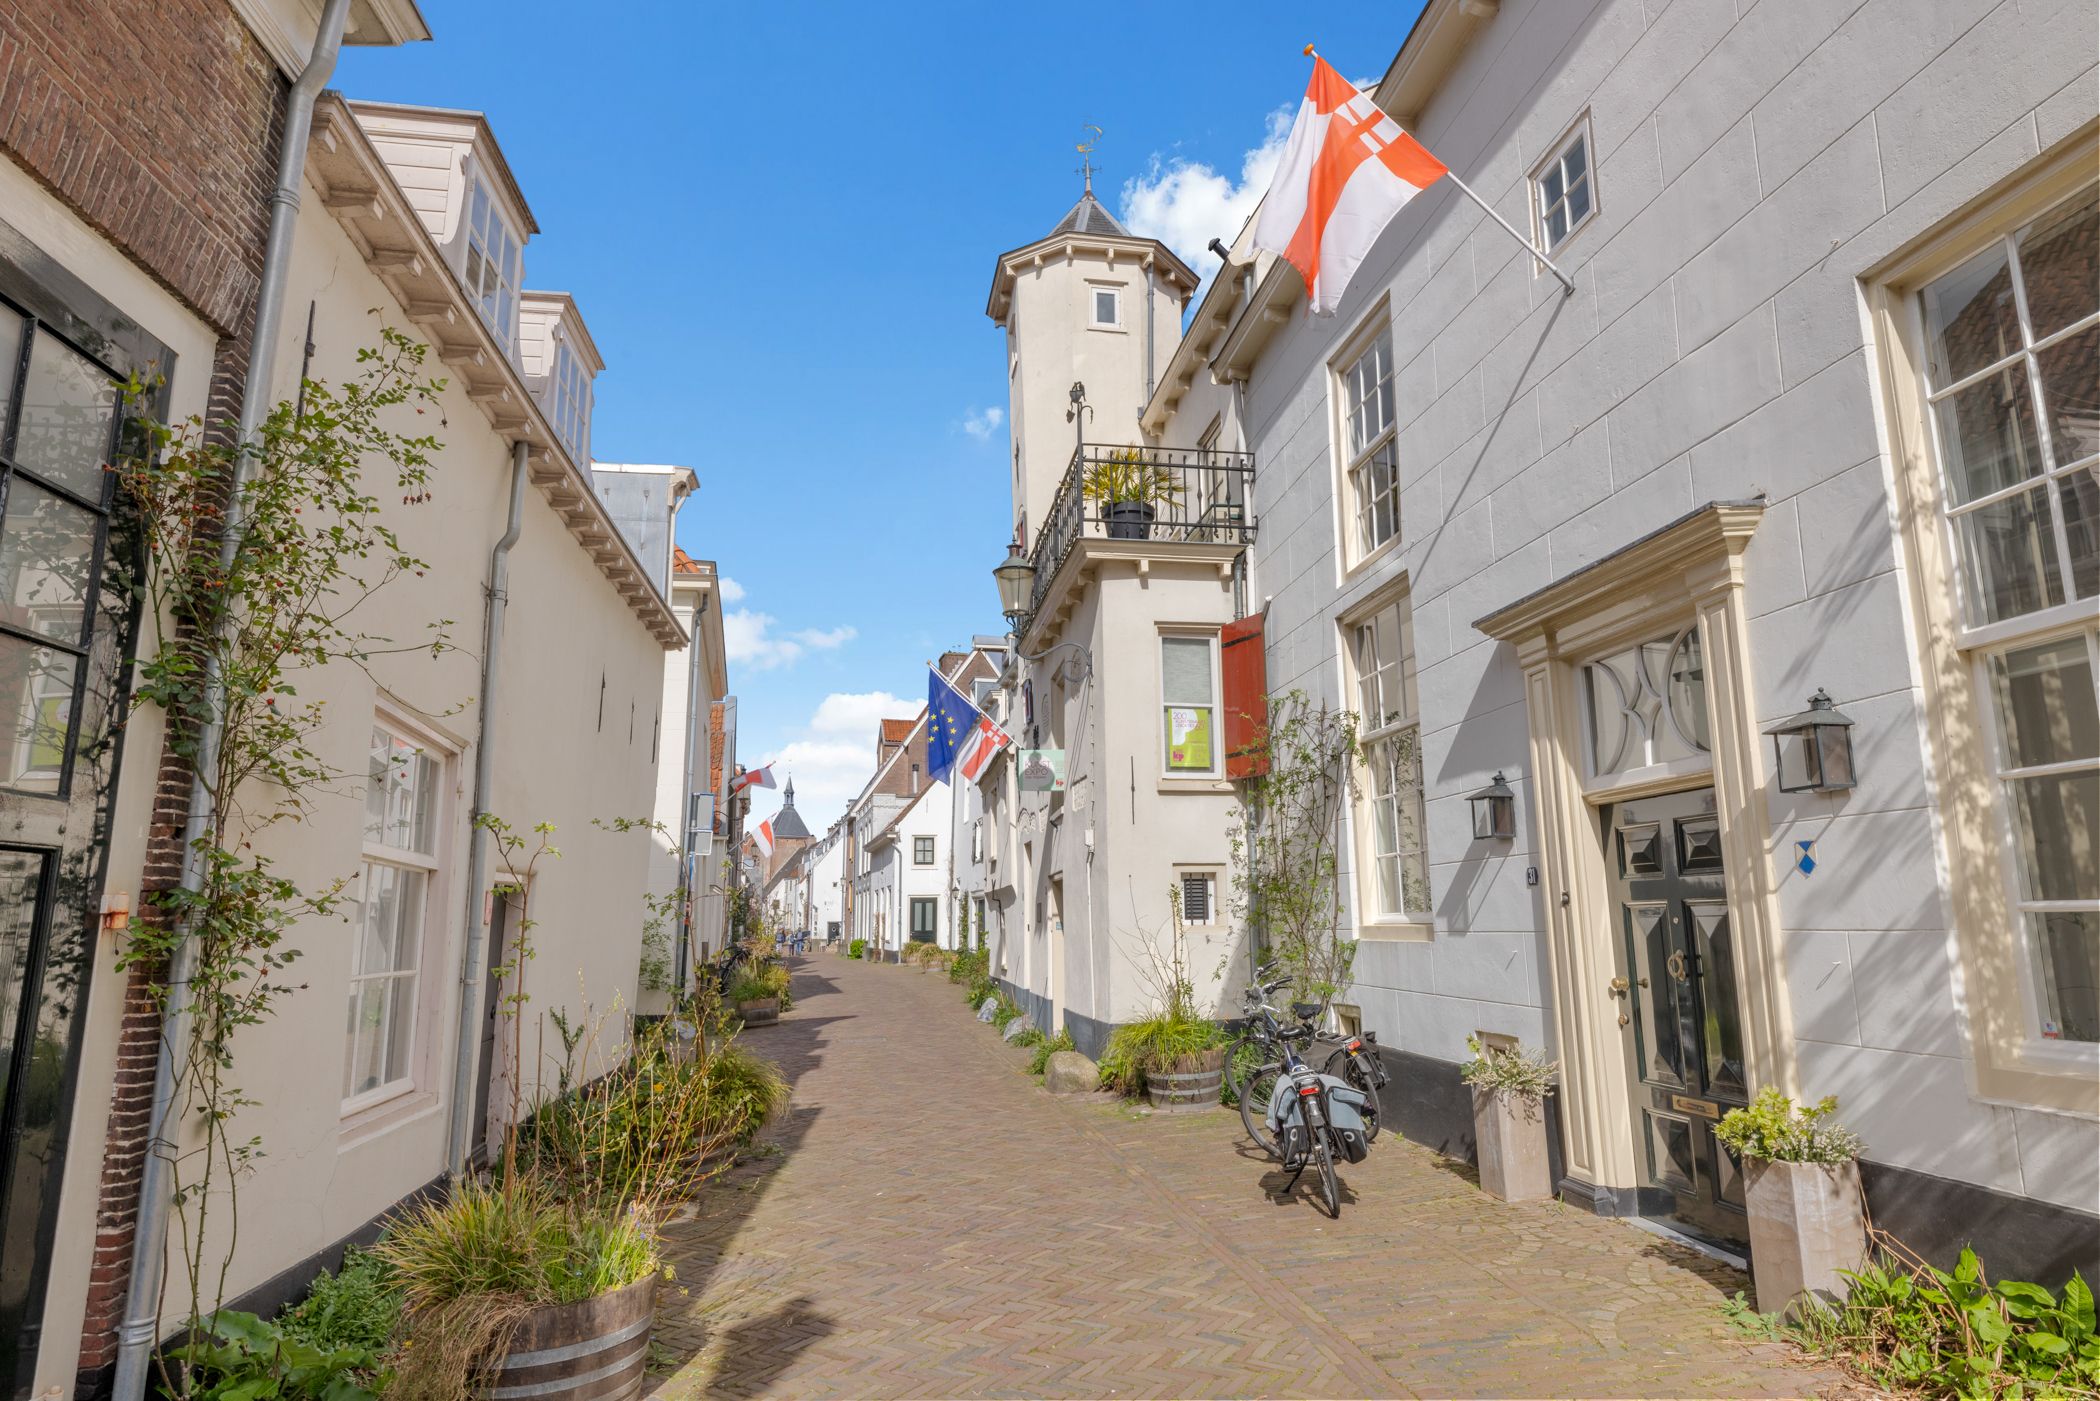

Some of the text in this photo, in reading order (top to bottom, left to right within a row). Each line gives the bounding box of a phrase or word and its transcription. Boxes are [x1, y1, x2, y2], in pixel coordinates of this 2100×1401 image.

[1173, 711, 1187, 719] 200
[1173, 750, 1184, 761] kp
[1025, 760, 1050, 769] KUNST
[1528, 868, 1536, 883] 31
